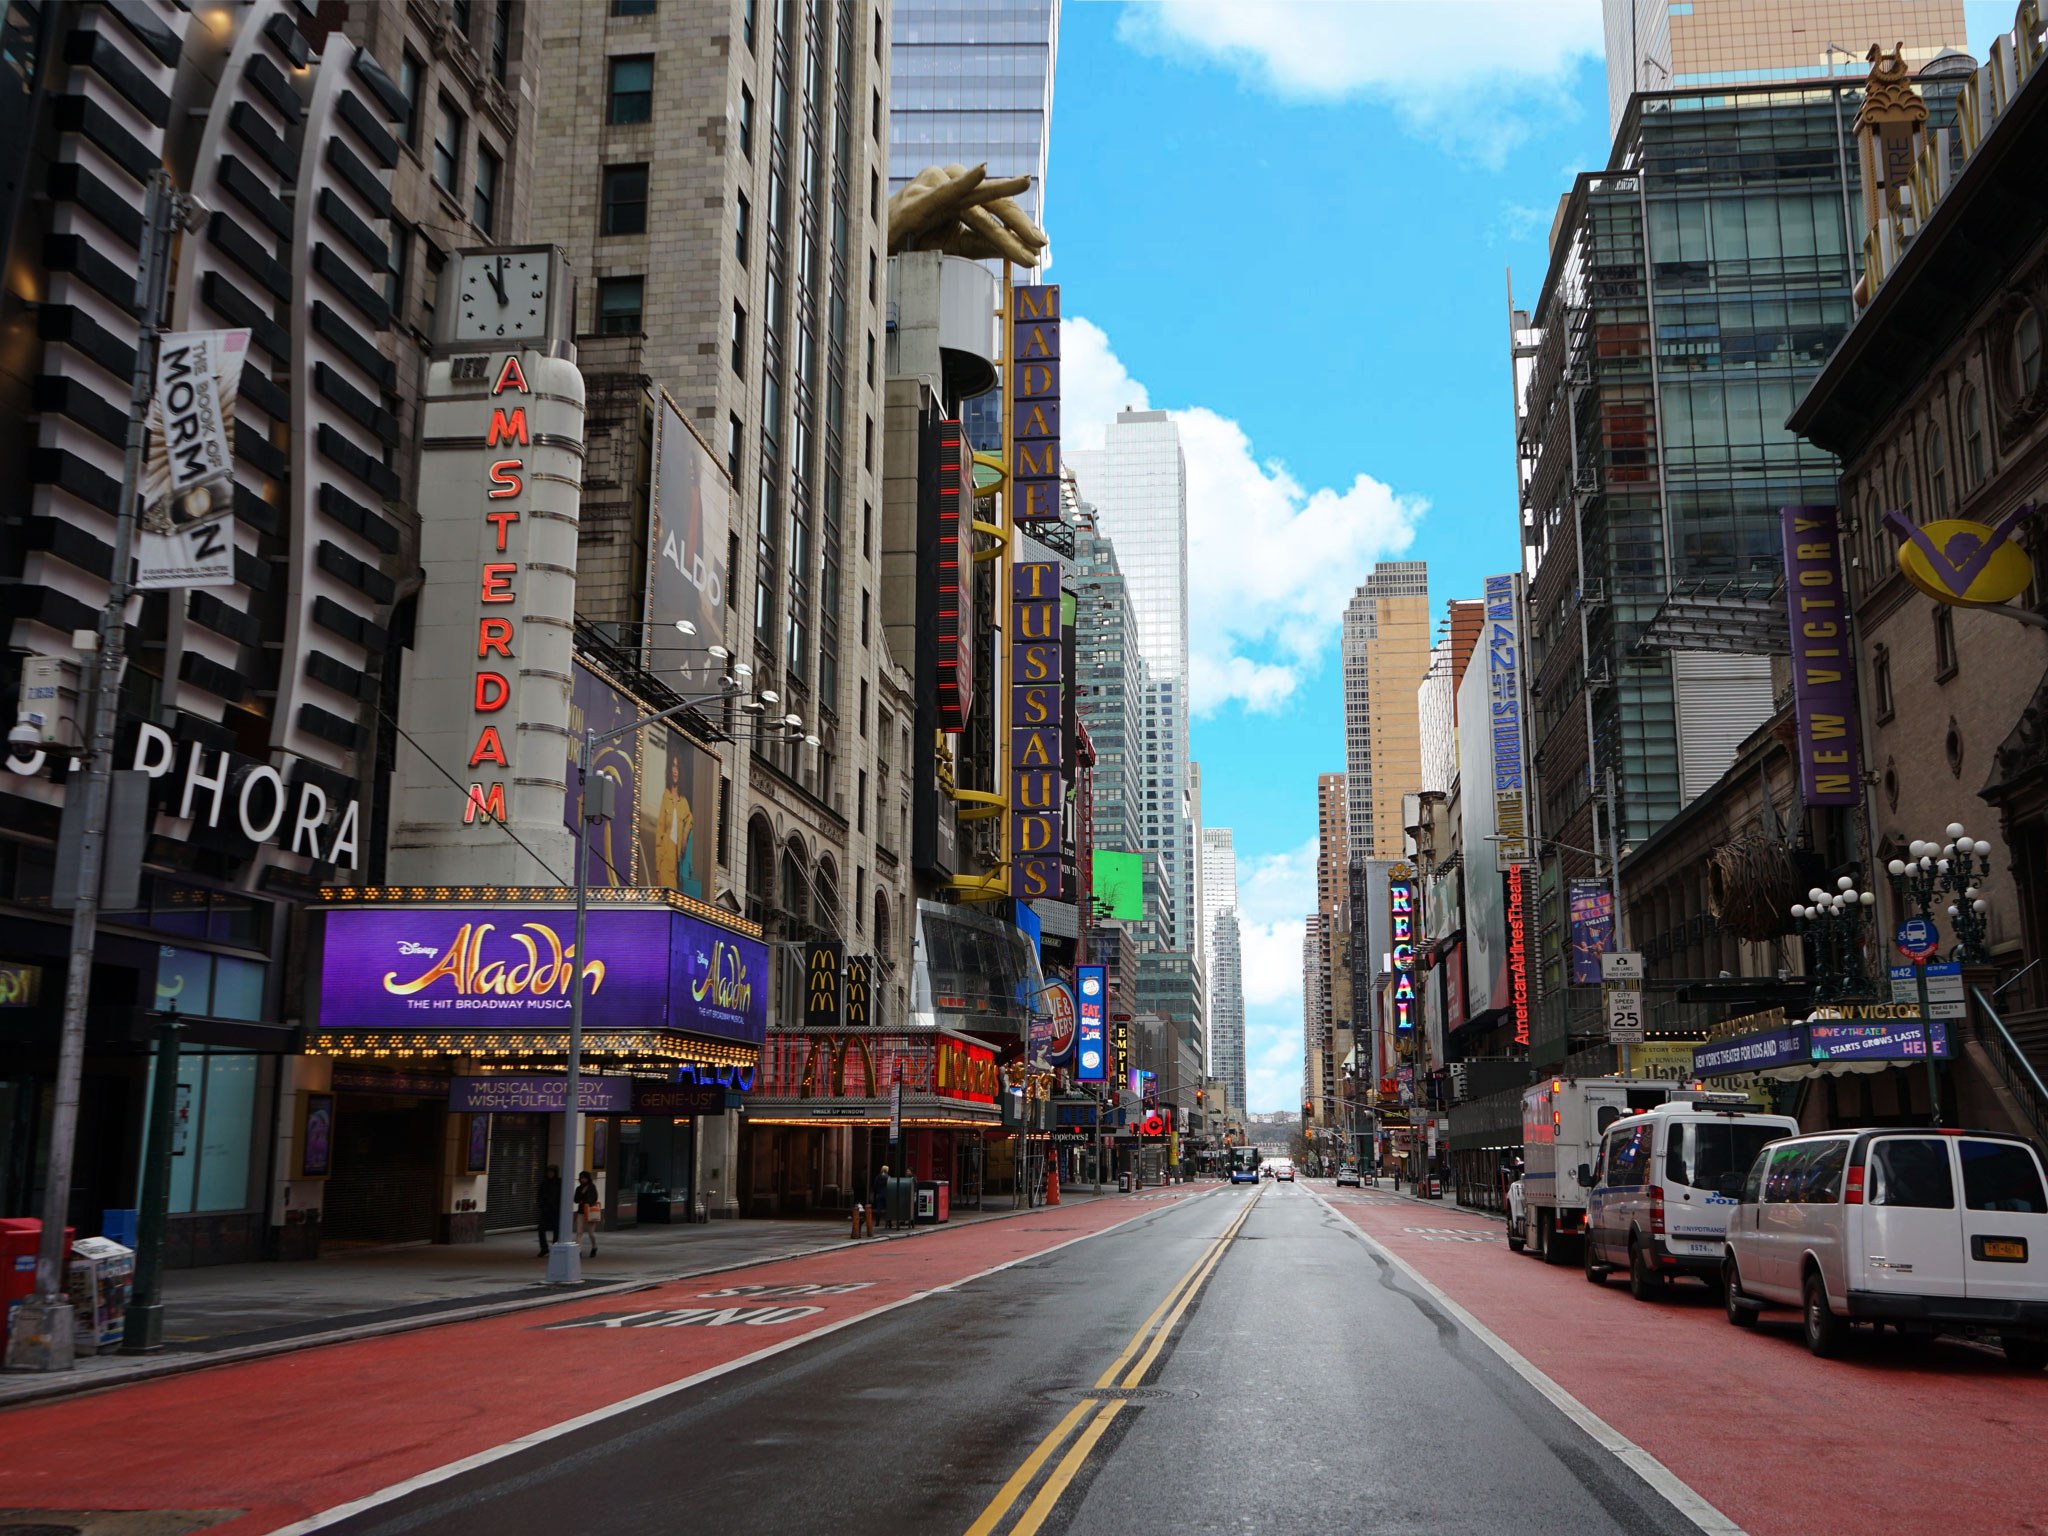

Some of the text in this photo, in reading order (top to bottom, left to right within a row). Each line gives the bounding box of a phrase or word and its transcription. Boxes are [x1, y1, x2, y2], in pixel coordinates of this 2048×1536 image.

[451, 357, 489, 378] NEW
[192, 340, 223, 468] THE BOOK OF
[1018, 287, 1054, 516] MADAME
[661, 528, 721, 607] ALDO
[462, 355, 531, 825] AMSTERDAM
[1486, 576, 1514, 620] NEW
[1794, 517, 1850, 794] NEW VICTORY
[1492, 701, 1522, 790] STUDIOS
[384, 922, 606, 995] Aladdin
[396, 941, 439, 958] Disney
[1391, 887, 1415, 1028] REGAL
[692, 940, 751, 1013] Aladdin
[1891, 967, 1911, 978] M42
[407, 999, 573, 1009] THE HIT BROADWAY MUSICA
[1081, 1002, 1100, 1018] EAT.
[1815, 1004, 1921, 1019] NEW VICTOR
[1614, 1012, 1638, 1027] 25
[1812, 1028, 1840, 1037] LOVE
[1848, 1027, 1887, 1036] THEATER
[1830, 1030, 1921, 1054] STARTS GROWS LASTS
[1695, 1037, 1800, 1068] NEW YORK'S THEATER FOR KIDS AND FAMILIES
[542, 1082, 603, 1094] COEDY
[467, 1095, 613, 1108] WISH-FULFILLENT!”
[1705, 1198, 1737, 1206] POL
[545, 1306, 825, 1330] ONLY
